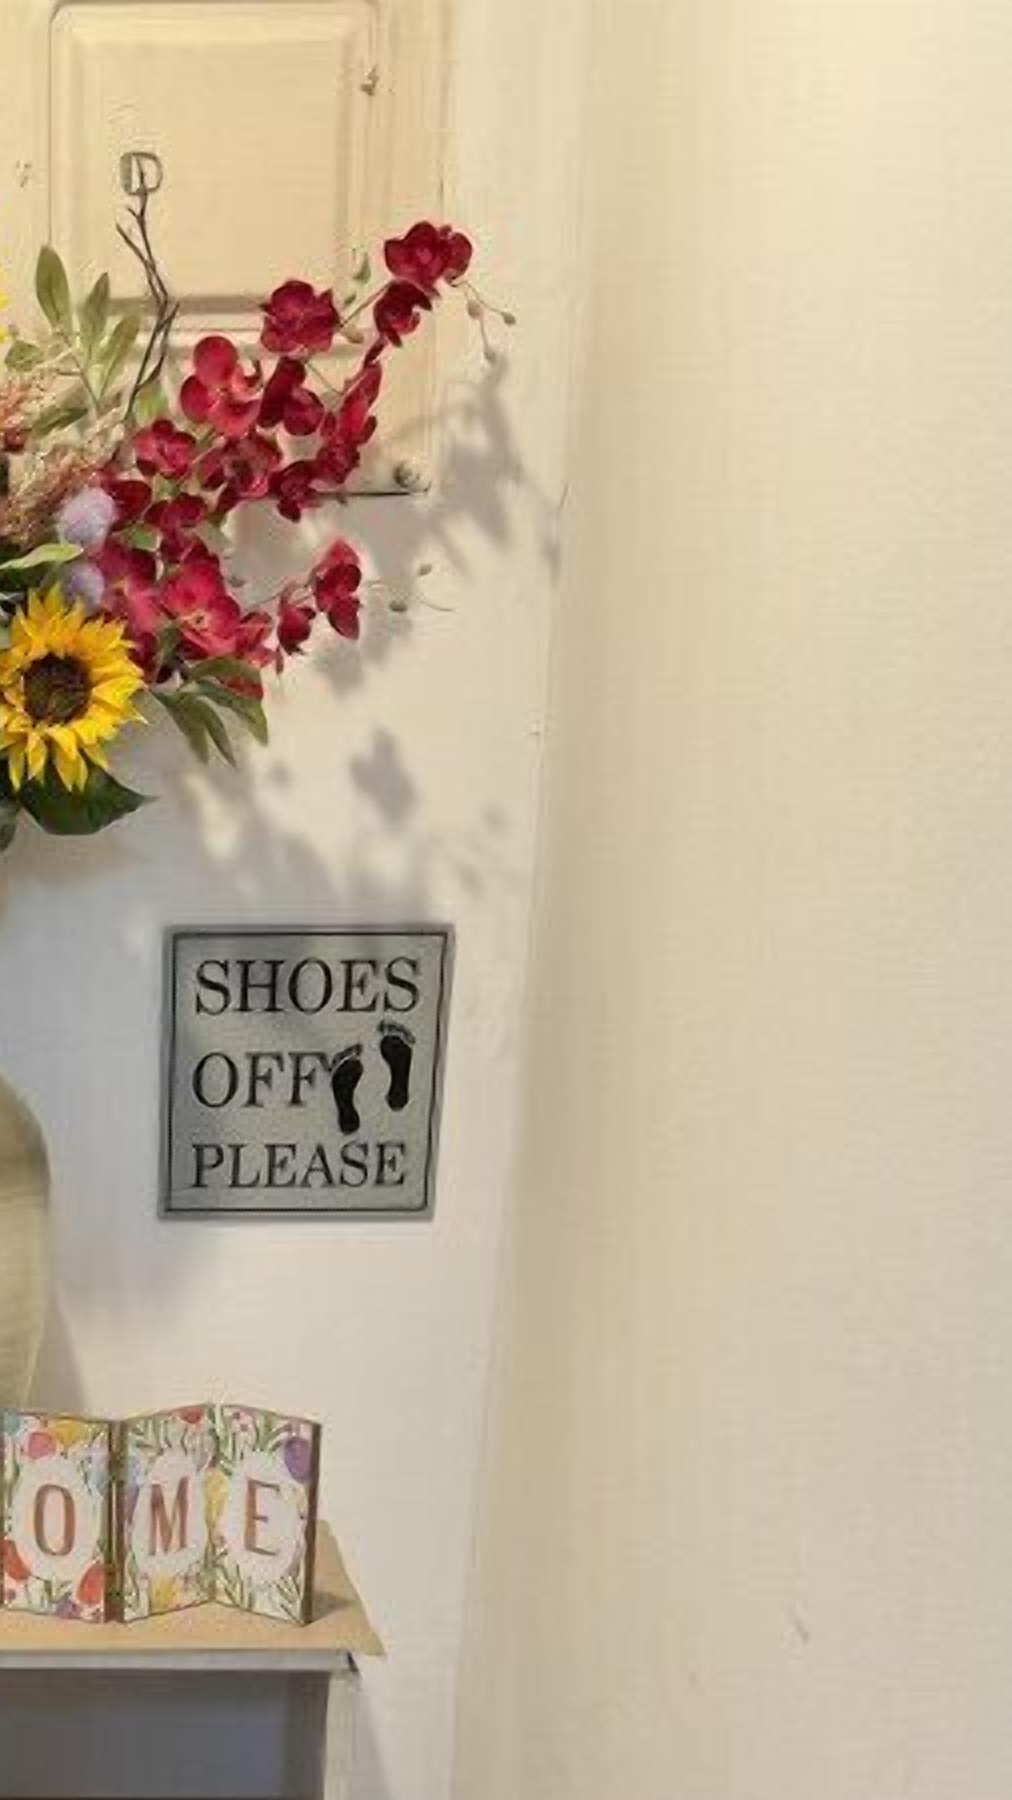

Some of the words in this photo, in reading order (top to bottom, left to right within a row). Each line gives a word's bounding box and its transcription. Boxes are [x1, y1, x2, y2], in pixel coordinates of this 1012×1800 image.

[195, 957, 421, 1015] SHOES
[192, 1052, 333, 1108] OFF
[191, 1141, 406, 1188] PLEASE
